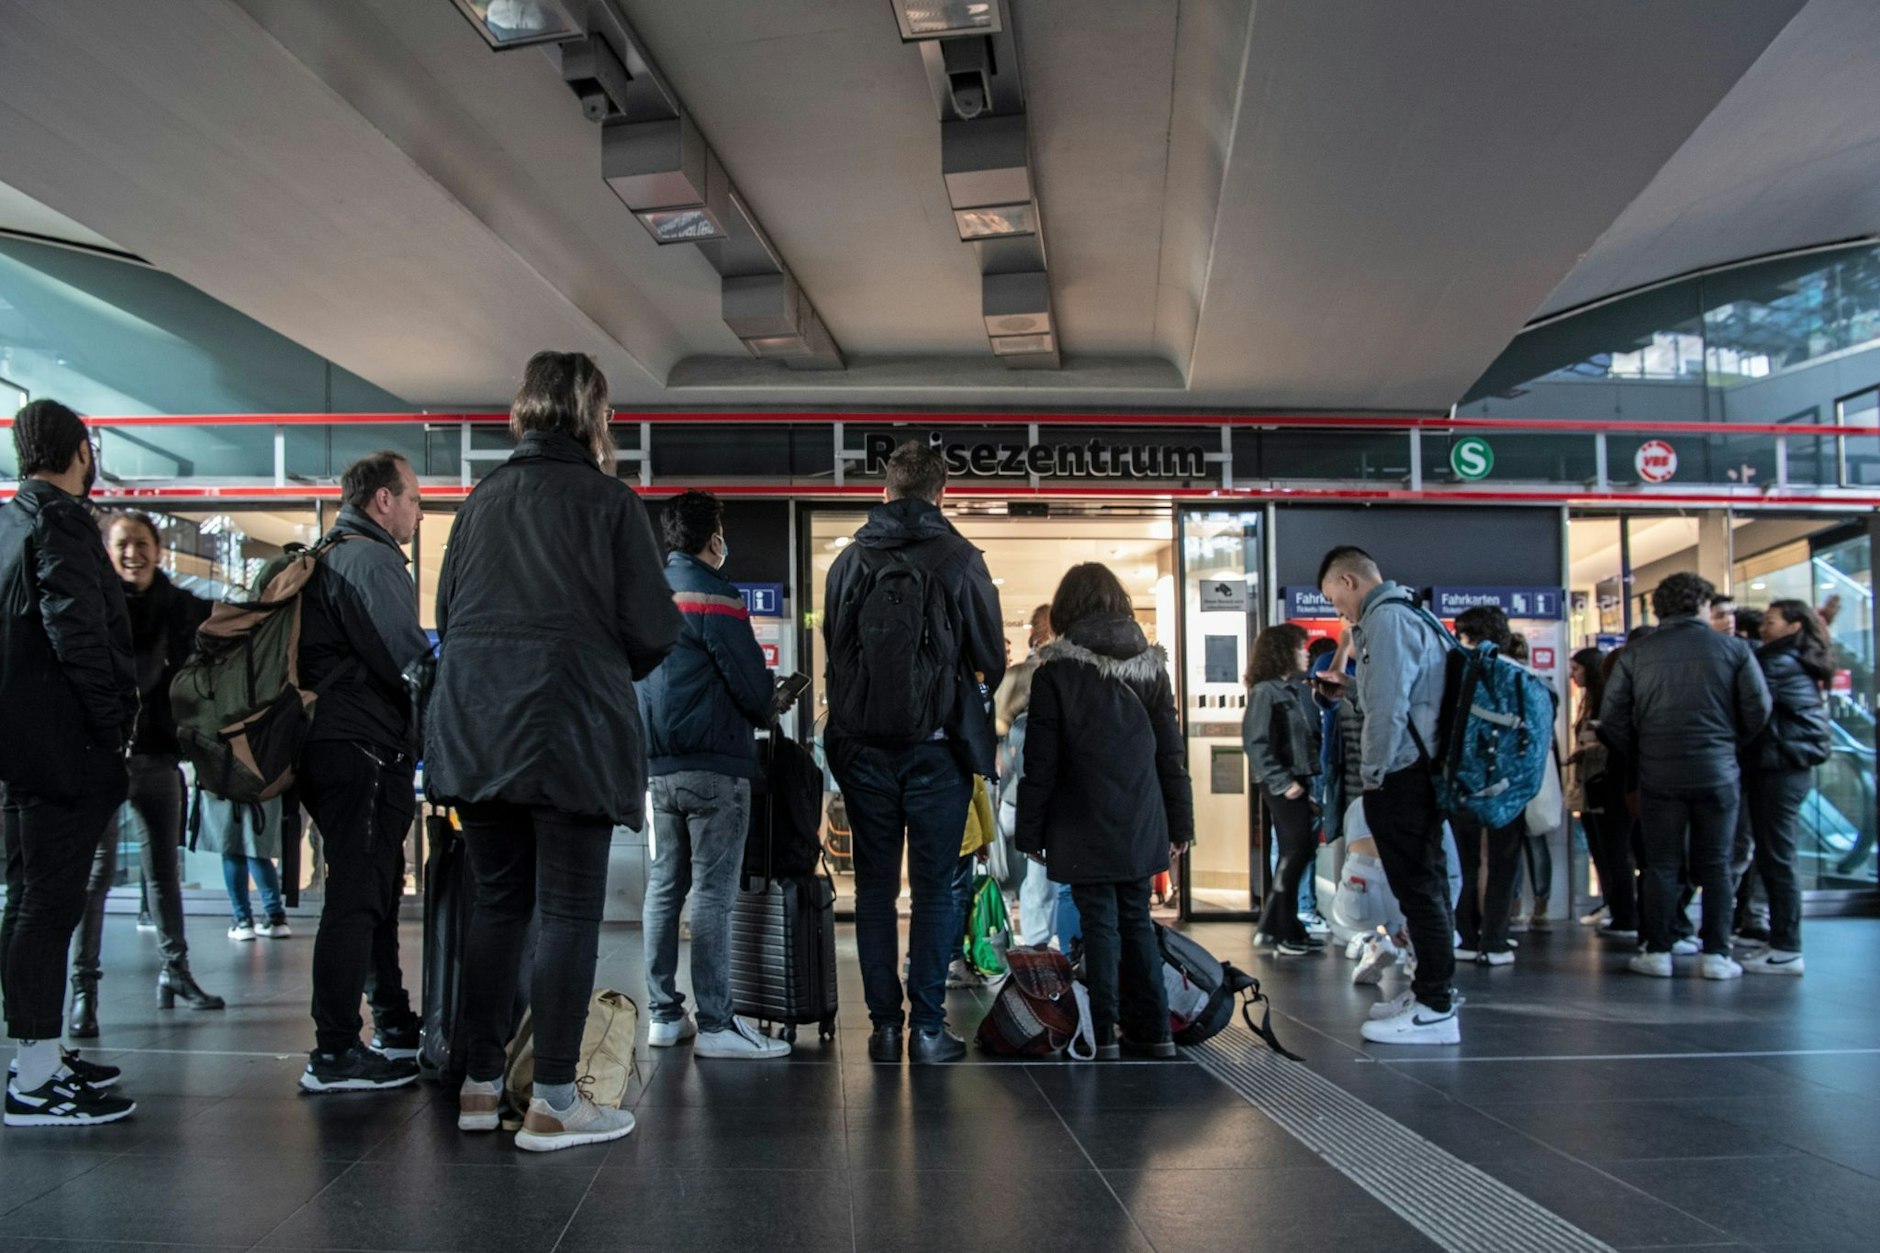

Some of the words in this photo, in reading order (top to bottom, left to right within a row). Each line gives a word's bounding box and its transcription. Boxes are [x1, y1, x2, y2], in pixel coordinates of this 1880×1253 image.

[864, 432, 1206, 477] Risezentrum
[1460, 442, 1487, 475] S
[1441, 592, 1500, 606] Fahrkarten
